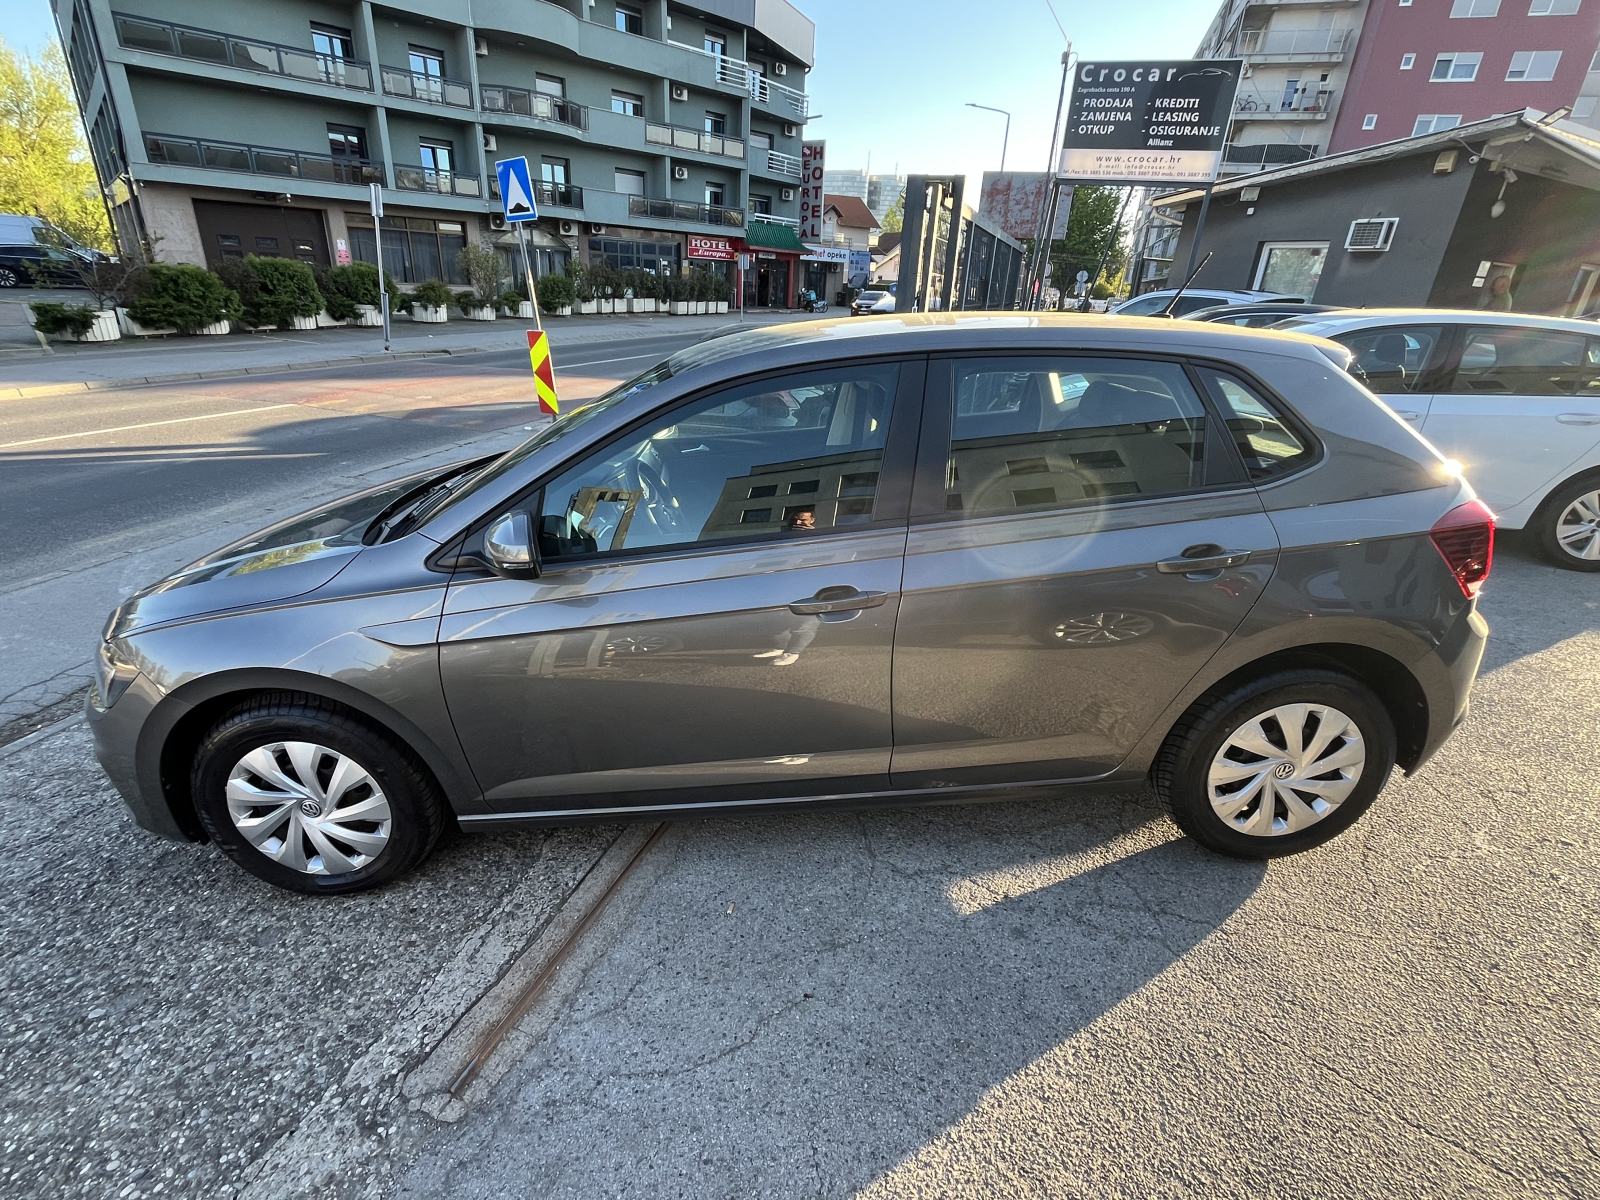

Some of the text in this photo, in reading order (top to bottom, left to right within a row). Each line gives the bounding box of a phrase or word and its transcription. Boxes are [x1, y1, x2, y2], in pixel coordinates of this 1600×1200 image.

[1080, 64, 1177, 82] Crocar
[1083, 98, 1133, 108] PRODAJA
[1154, 98, 1200, 108] KREDITI
[1080, 111, 1132, 121] ZAMJENA
[1152, 111, 1200, 122] LEASING
[1078, 124, 1115, 135] OTKUP
[1149, 125, 1221, 136] OSIGURANJE
[1147, 138, 1174, 146] Allianz
[1096, 155, 1182, 163] www.crocar.hr
[811, 145, 824, 237] HOTEL
[800, 160, 811, 239] EUROPA
[691, 238, 732, 250] HOTEL
[826, 250, 847, 260] opeke
